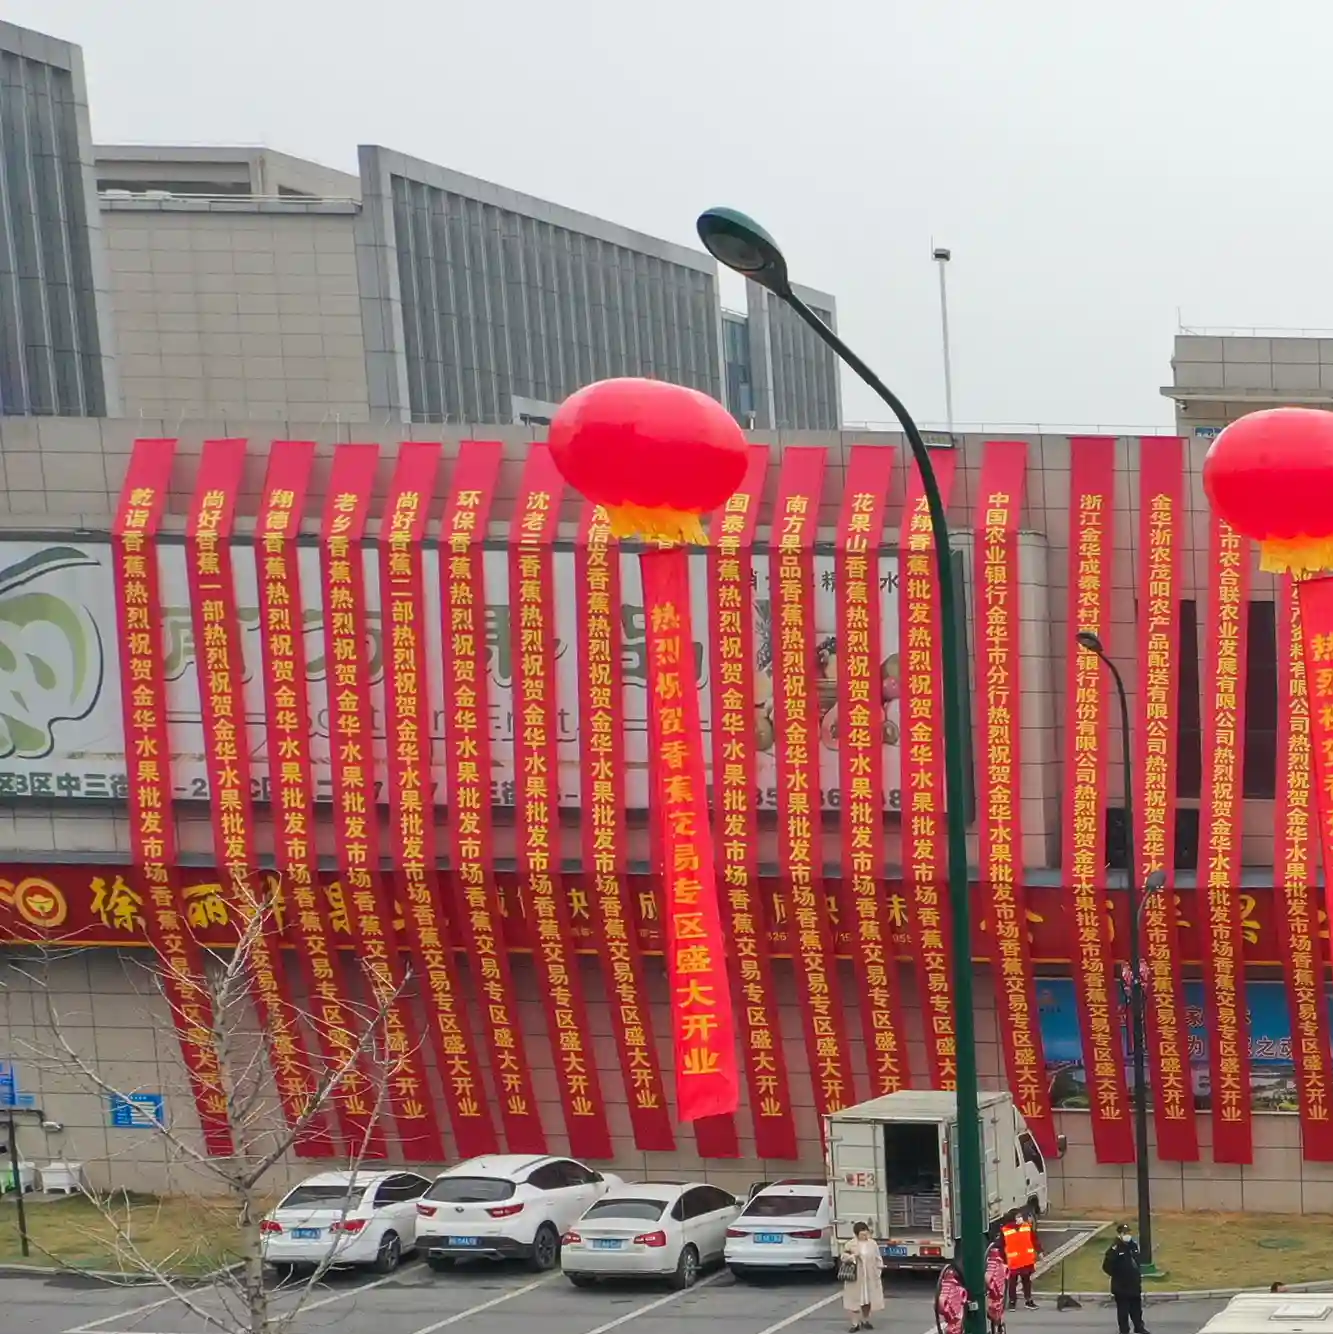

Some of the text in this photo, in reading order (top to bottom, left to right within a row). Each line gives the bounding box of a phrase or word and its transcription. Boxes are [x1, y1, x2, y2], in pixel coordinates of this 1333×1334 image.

[389, 492, 478, 1116] 尚好香蕉二部热烈祝贺金华水果批发市场香蕉交易专区盛大开业
[449, 490, 523, 1113] 环保香蕉热烈祝贺金华水果批发市场香蕉交易专区盛大开业
[520, 492, 589, 1116] 沈老三香蕉热烈祝贺金华水果批发市场香蕉交易专区盛大开业
[652, 605, 716, 1075] 热烈祝贺香蕉交易专区盛大开业
[1141, 494, 1188, 1121] 金华浙农茂阳农产品配送有限公司热烈祝贺金华水批发市场香蕉交易专区盛大开业
